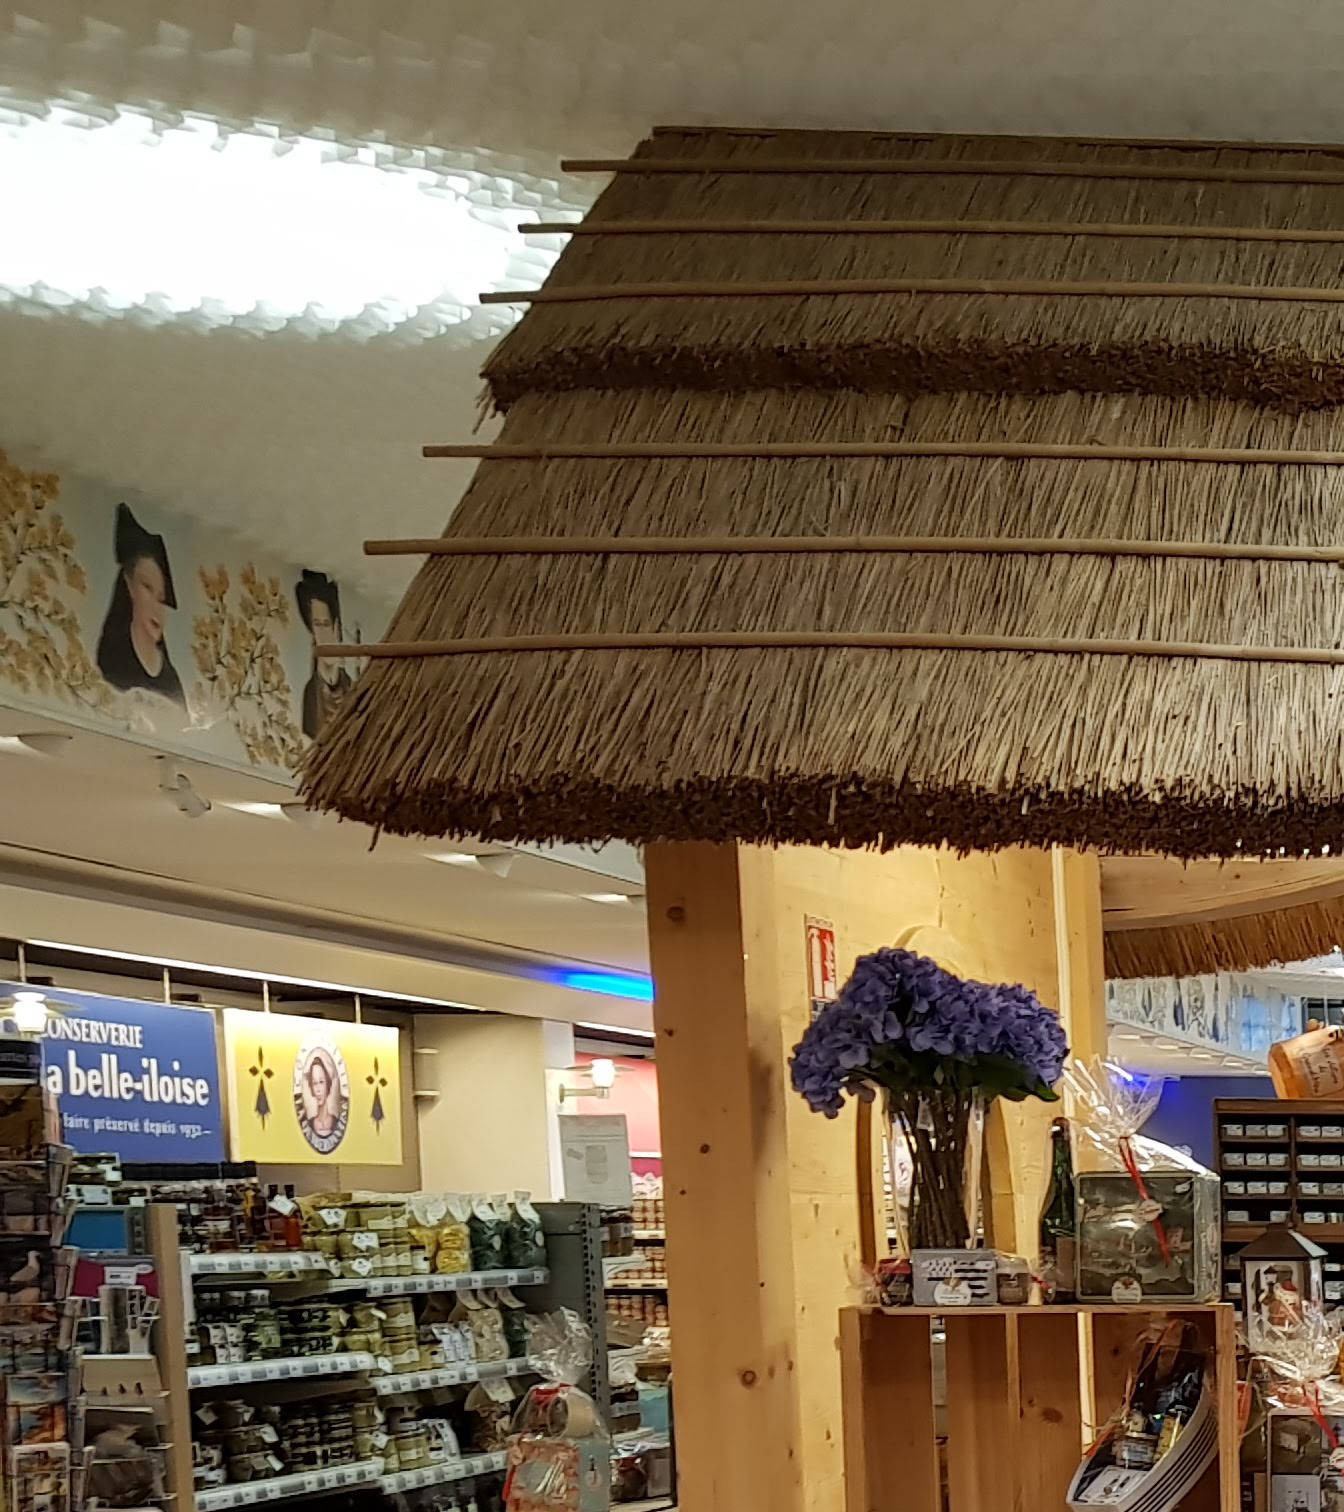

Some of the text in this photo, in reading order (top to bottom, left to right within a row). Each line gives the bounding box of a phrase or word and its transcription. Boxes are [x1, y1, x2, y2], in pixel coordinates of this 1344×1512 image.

[43, 1018, 143, 1049] ONSERVERIE
[46, 1049, 210, 1107] a belle-iloise
[143, 1115, 177, 1136] depuis
